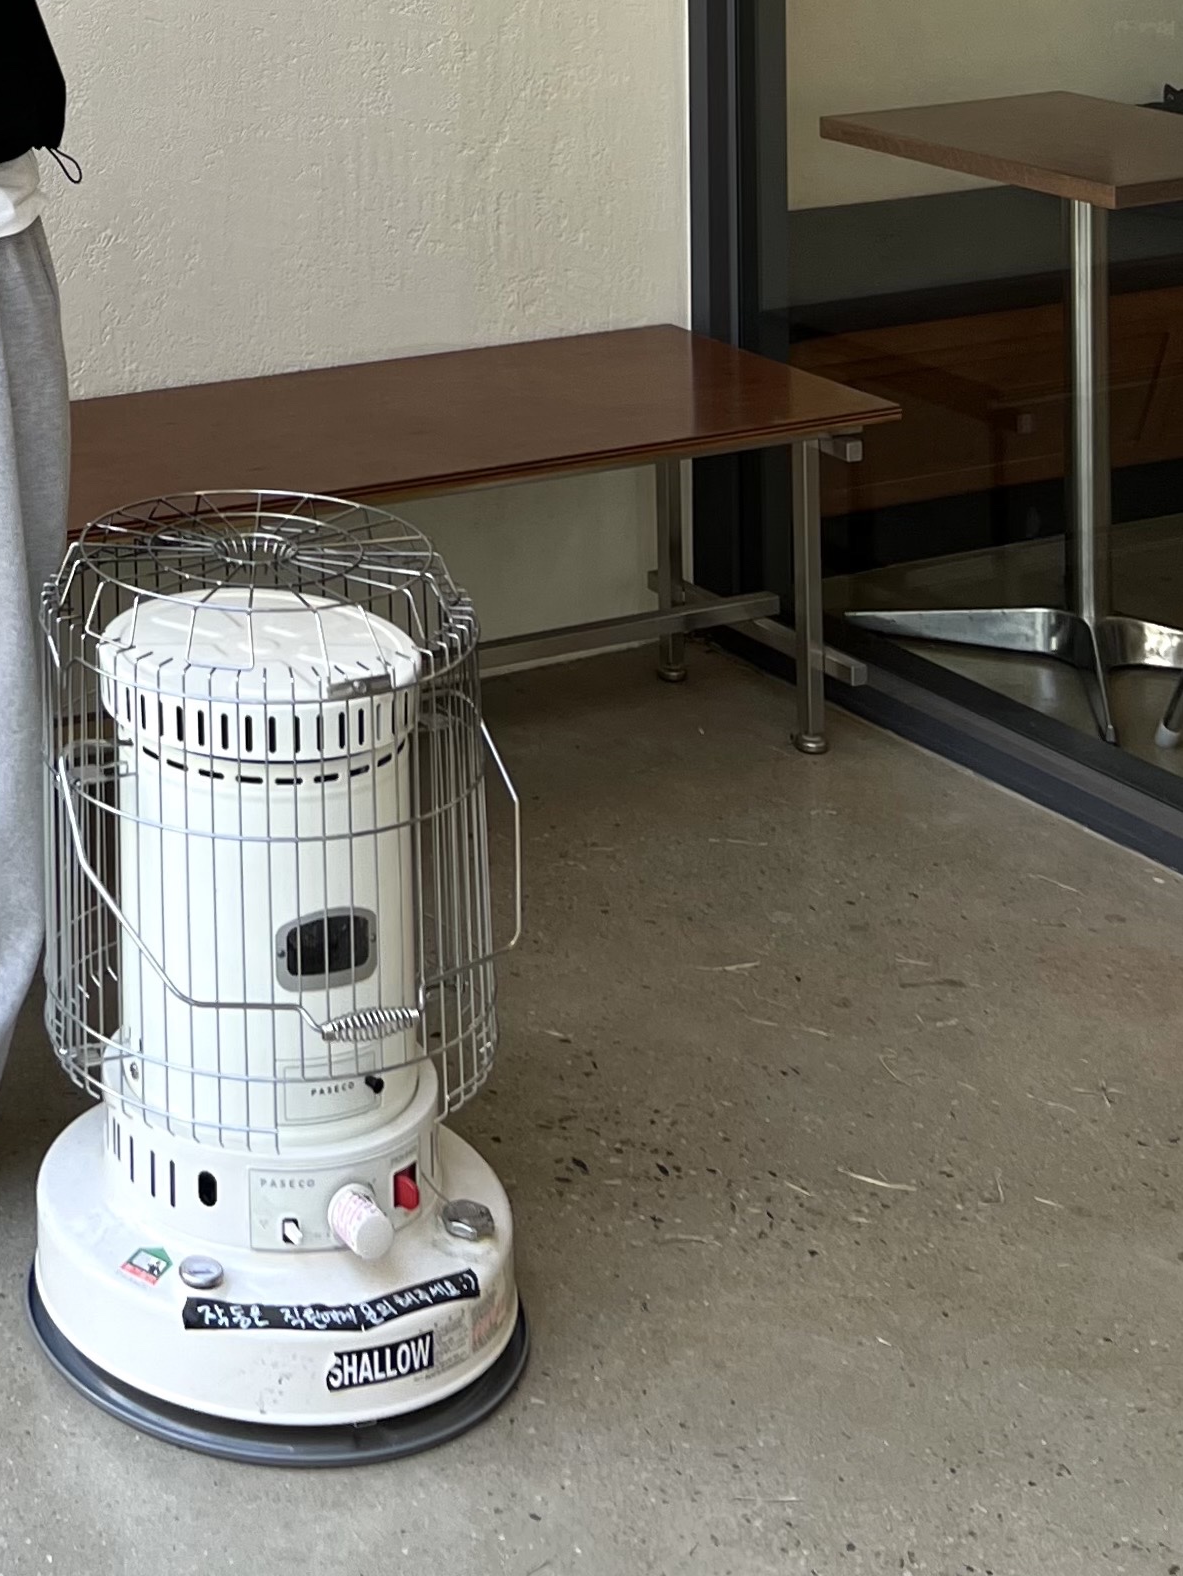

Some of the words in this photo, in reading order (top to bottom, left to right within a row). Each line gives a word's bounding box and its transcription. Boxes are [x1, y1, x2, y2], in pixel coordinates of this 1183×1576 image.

[310, 1080, 356, 1097] PASECO
[259, 1177, 317, 1190] PASECO
[196, 1303, 270, 1330] 작동은
[279, 1305, 359, 1330] 직원에게
[327, 1334, 431, 1389] SHALLOW
